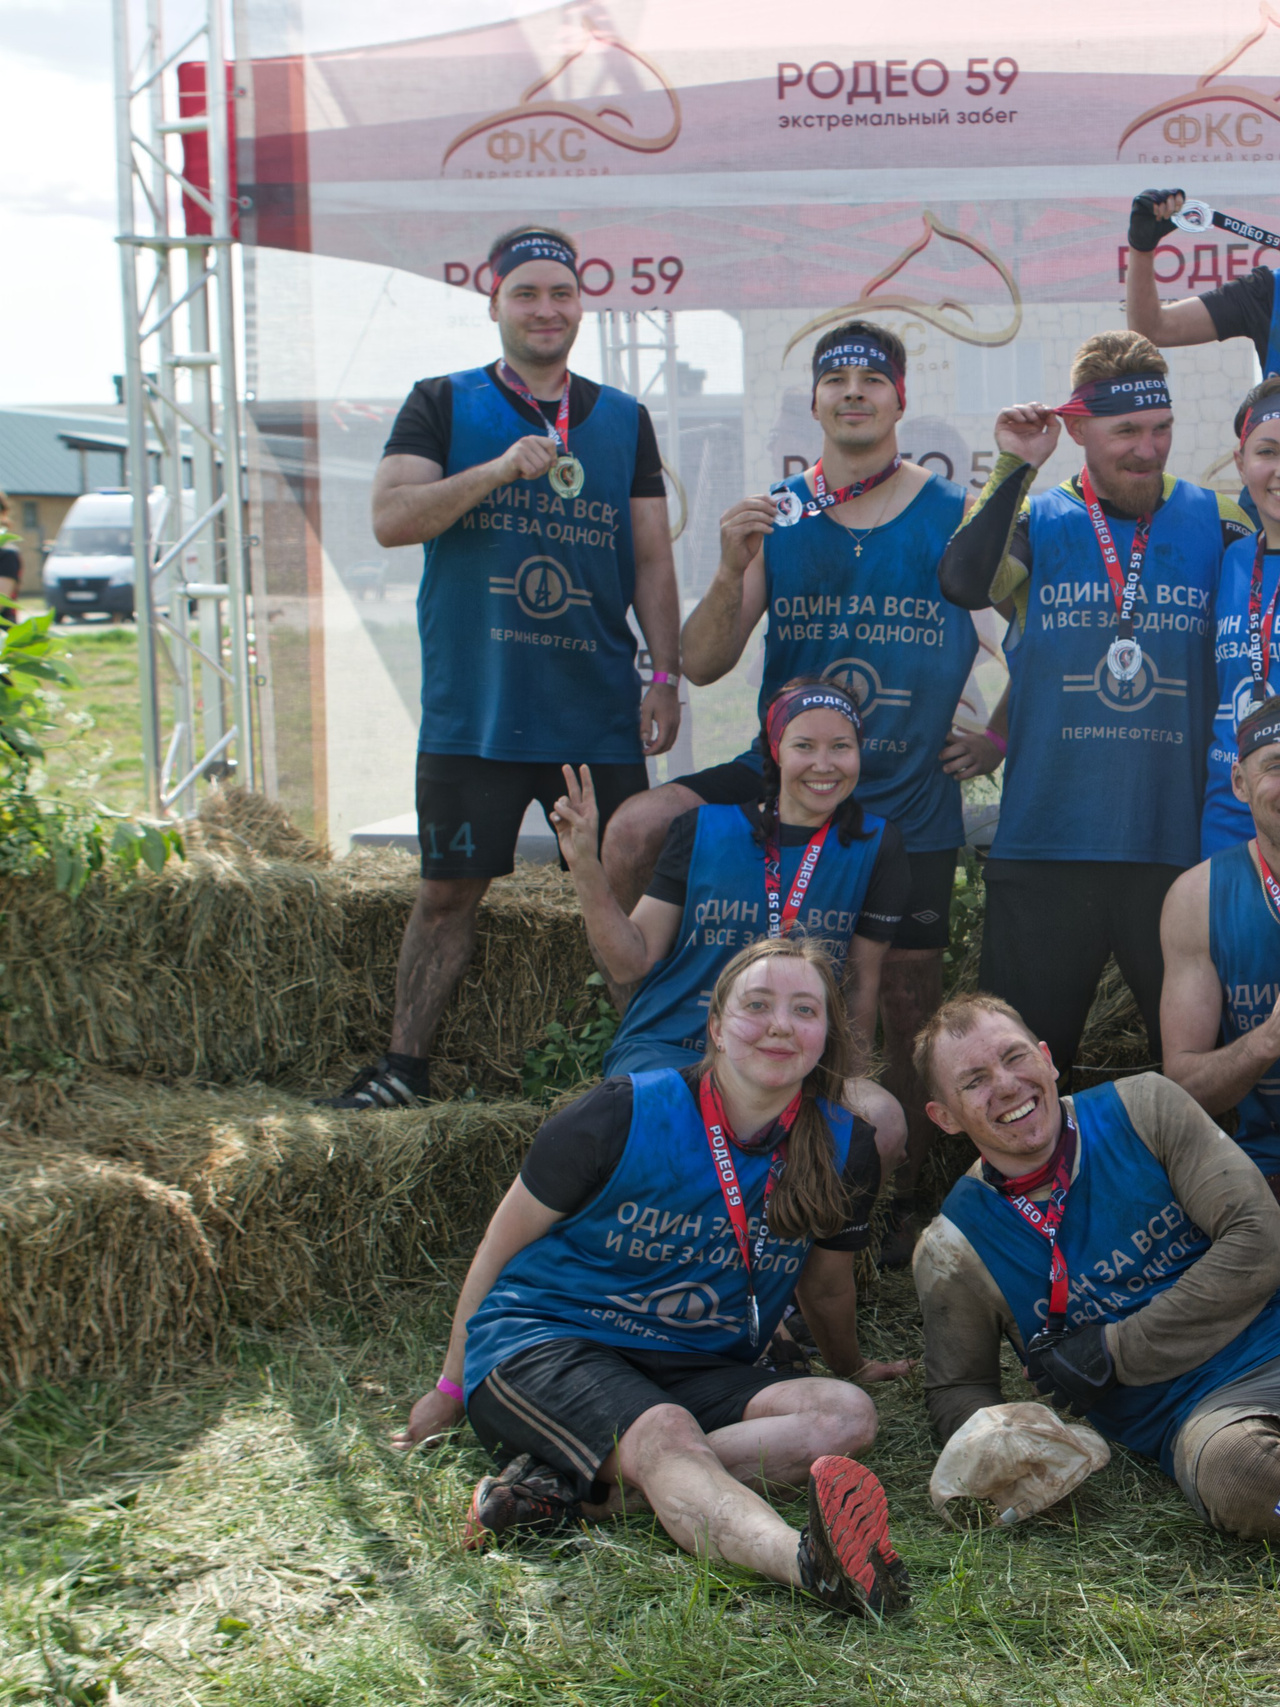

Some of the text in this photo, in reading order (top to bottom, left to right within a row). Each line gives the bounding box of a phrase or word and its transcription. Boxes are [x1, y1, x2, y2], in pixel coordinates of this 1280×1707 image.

[776, 57, 1019, 105] РОДЕО 59
[778, 107, 1018, 131] экстремальный забег
[1163, 112, 1263, 148] ФКС
[486, 127, 587, 163] ФКС
[1224, 217, 1280, 246] РОДЕО 59
[630, 256, 684, 296] 59
[819, 345, 886, 364] РОДЕО 59
[832, 357, 868, 367] 3158
[1111, 380, 1161, 394] РОДЕО
[1134, 393, 1167, 406] 3174
[1262, 411, 1280, 422] 59
[536, 492, 566, 517] ЗА
[819, 494, 835, 508] 59
[462, 512, 543, 536] И ВСЕ ЗА
[1089, 503, 1117, 563] РОДЕО 59
[1121, 552, 1142, 619] РОДЕО 59
[774, 595, 946, 627] ОДИН ЗА ВСЕХ,
[1039, 582, 1210, 617] ОДИН ВСЕХ,
[1042, 613, 1053, 630] И
[1057, 610, 1091, 628] ВСЕ
[1097, 610, 1120, 627] ЗА
[828, 622, 849, 640] ЗА
[855, 623, 944, 647] ОДНОГО!
[1250, 613, 1263, 681] РОДЕО 59
[802, 695, 851, 711] РОДЕО
[1062, 727, 1184, 745] ПЕРМНЕФТЕГАЗ
[790, 845, 821, 908] РОДЕО 59
[695, 899, 759, 925] ОДИН
[769, 892, 779, 908] 59
[704, 929, 737, 946] ВСЕ
[710, 1125, 740, 1206] РОДЕО 59
[618, 1201, 702, 1238] ОДИН
[605, 1230, 622, 1253] И
[628, 1242, 672, 1263] ВСЕ
[679, 1247, 705, 1265] ЗА
[1094, 1249, 1135, 1283] ЗА
